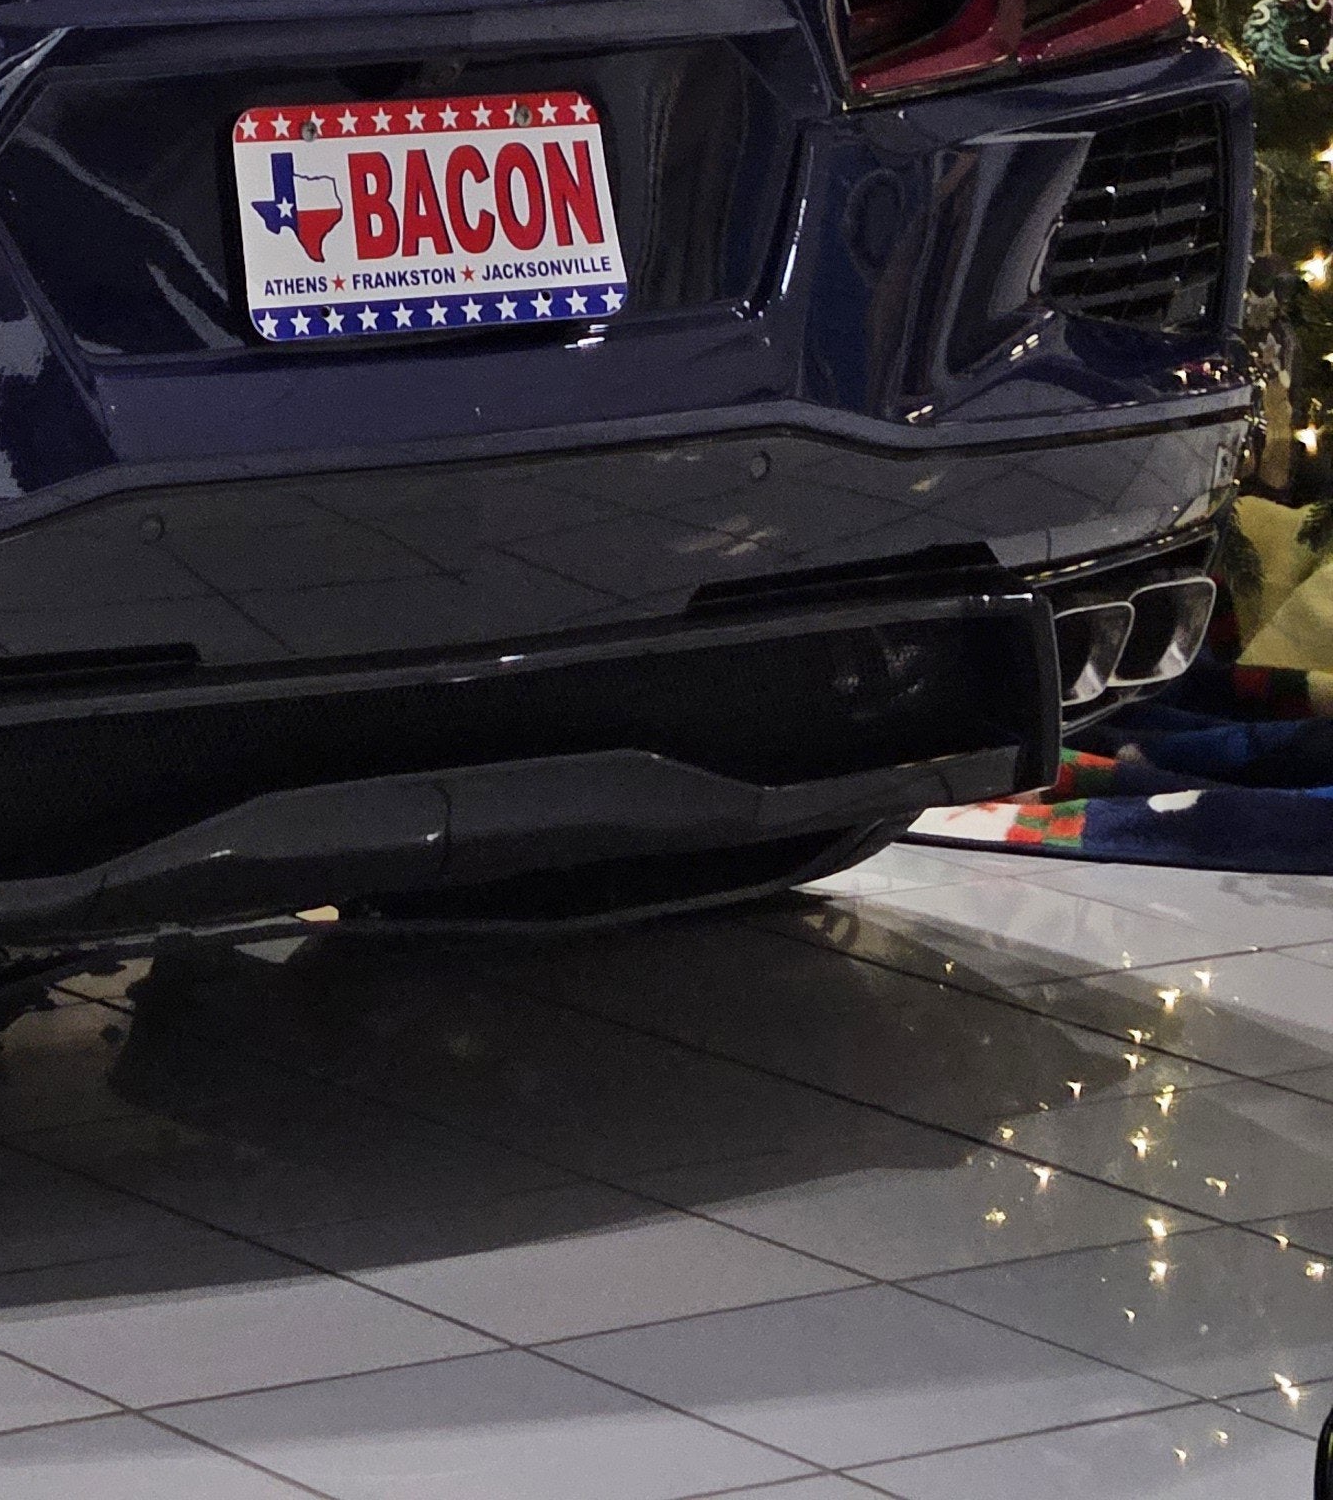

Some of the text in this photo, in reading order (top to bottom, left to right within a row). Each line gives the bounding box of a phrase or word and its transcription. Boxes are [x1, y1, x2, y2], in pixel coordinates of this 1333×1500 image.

[347, 140, 606, 261] BACON
[264, 256, 613, 297] ATHENS FRANKSTON JACKSONVILLE
